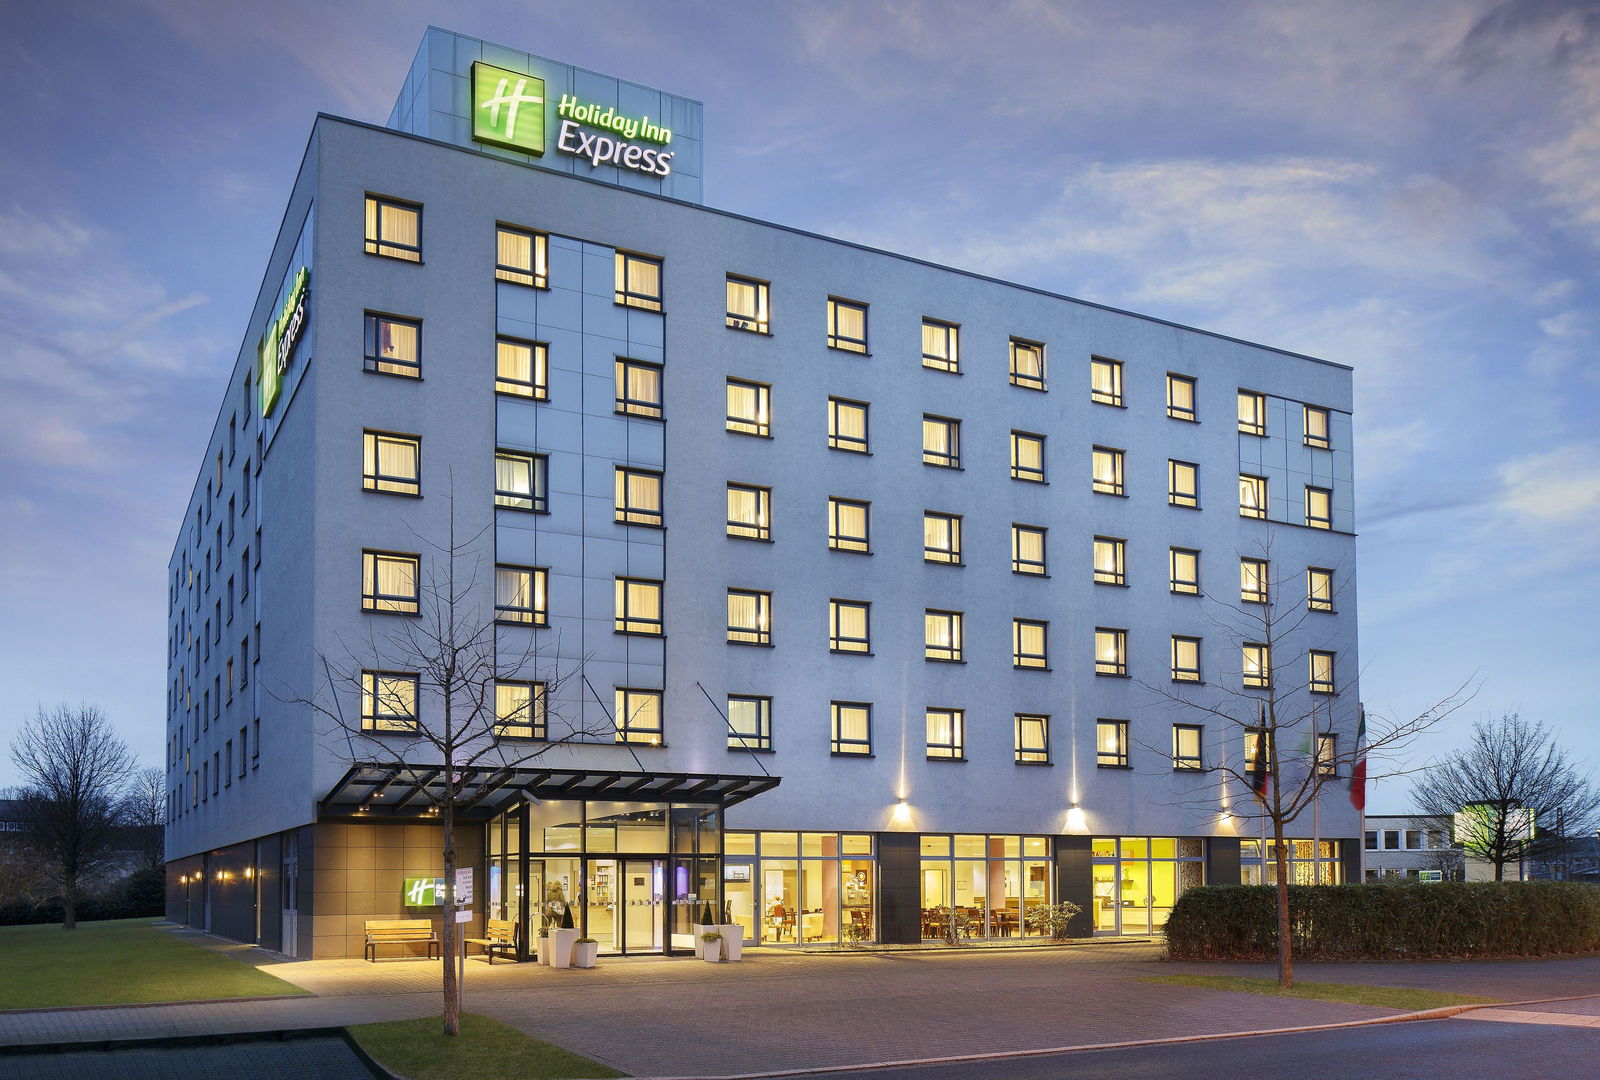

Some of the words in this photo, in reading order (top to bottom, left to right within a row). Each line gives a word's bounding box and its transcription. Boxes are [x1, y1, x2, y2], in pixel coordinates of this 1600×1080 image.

[558, 94, 639, 140] Holiday
[641, 115, 672, 144] Inn
[557, 119, 672, 176] Express
